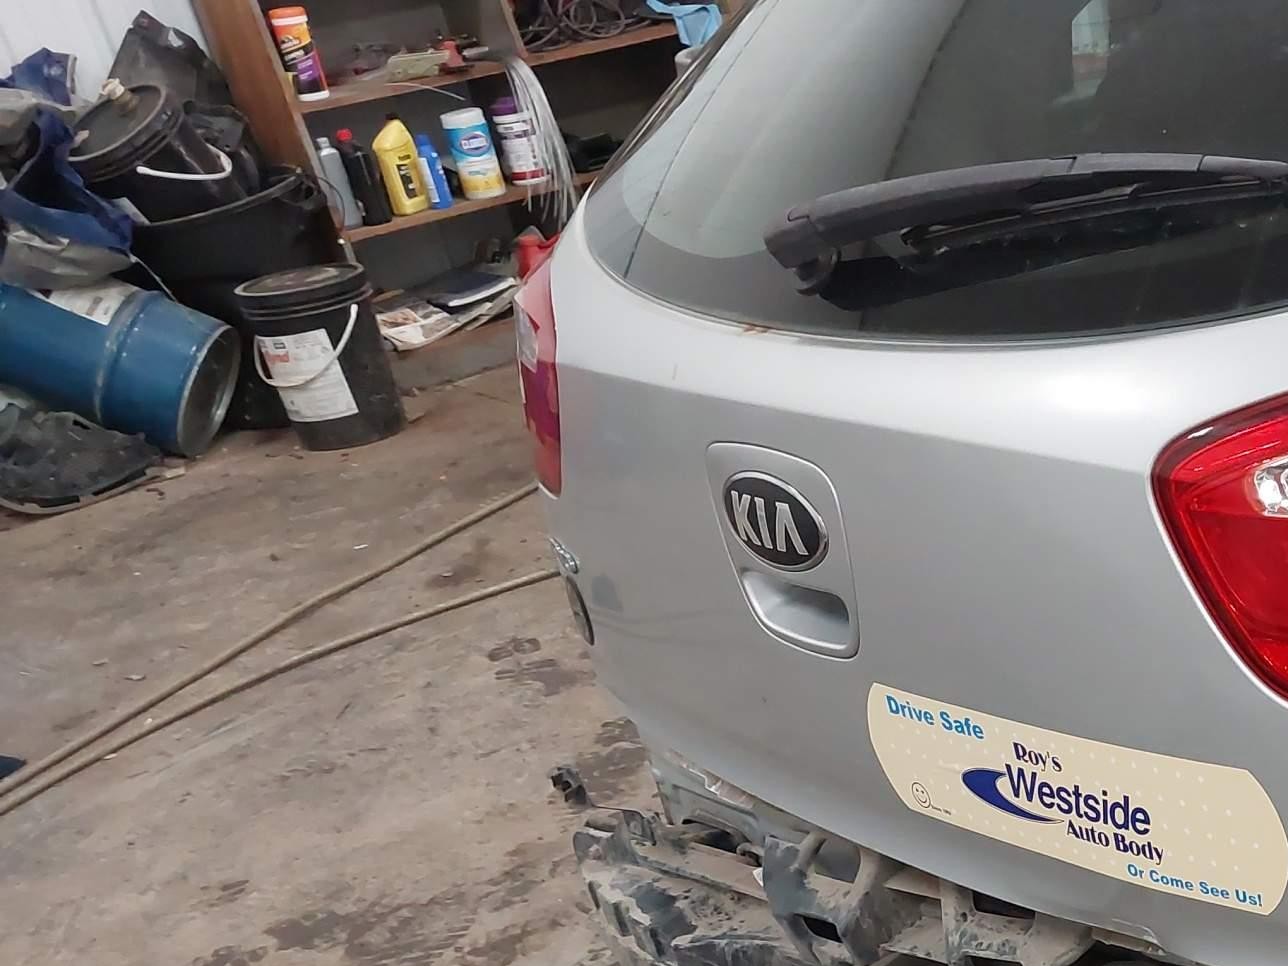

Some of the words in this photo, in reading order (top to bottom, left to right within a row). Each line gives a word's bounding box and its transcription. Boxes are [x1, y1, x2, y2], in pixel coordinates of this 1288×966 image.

[731, 490, 809, 555] KIA
[886, 694, 935, 725] Drive
[939, 710, 985, 739] Safe
[1012, 741, 1063, 772] Roy's
[1004, 763, 1151, 835] Westside
[1067, 819, 1110, 848] Auto
[1114, 832, 1164, 865] Body
[1127, 864, 1145, 879] Or
[1149, 870, 1194, 891] Come
[1199, 881, 1230, 899] See
[1235, 889, 1263, 906] Us!
